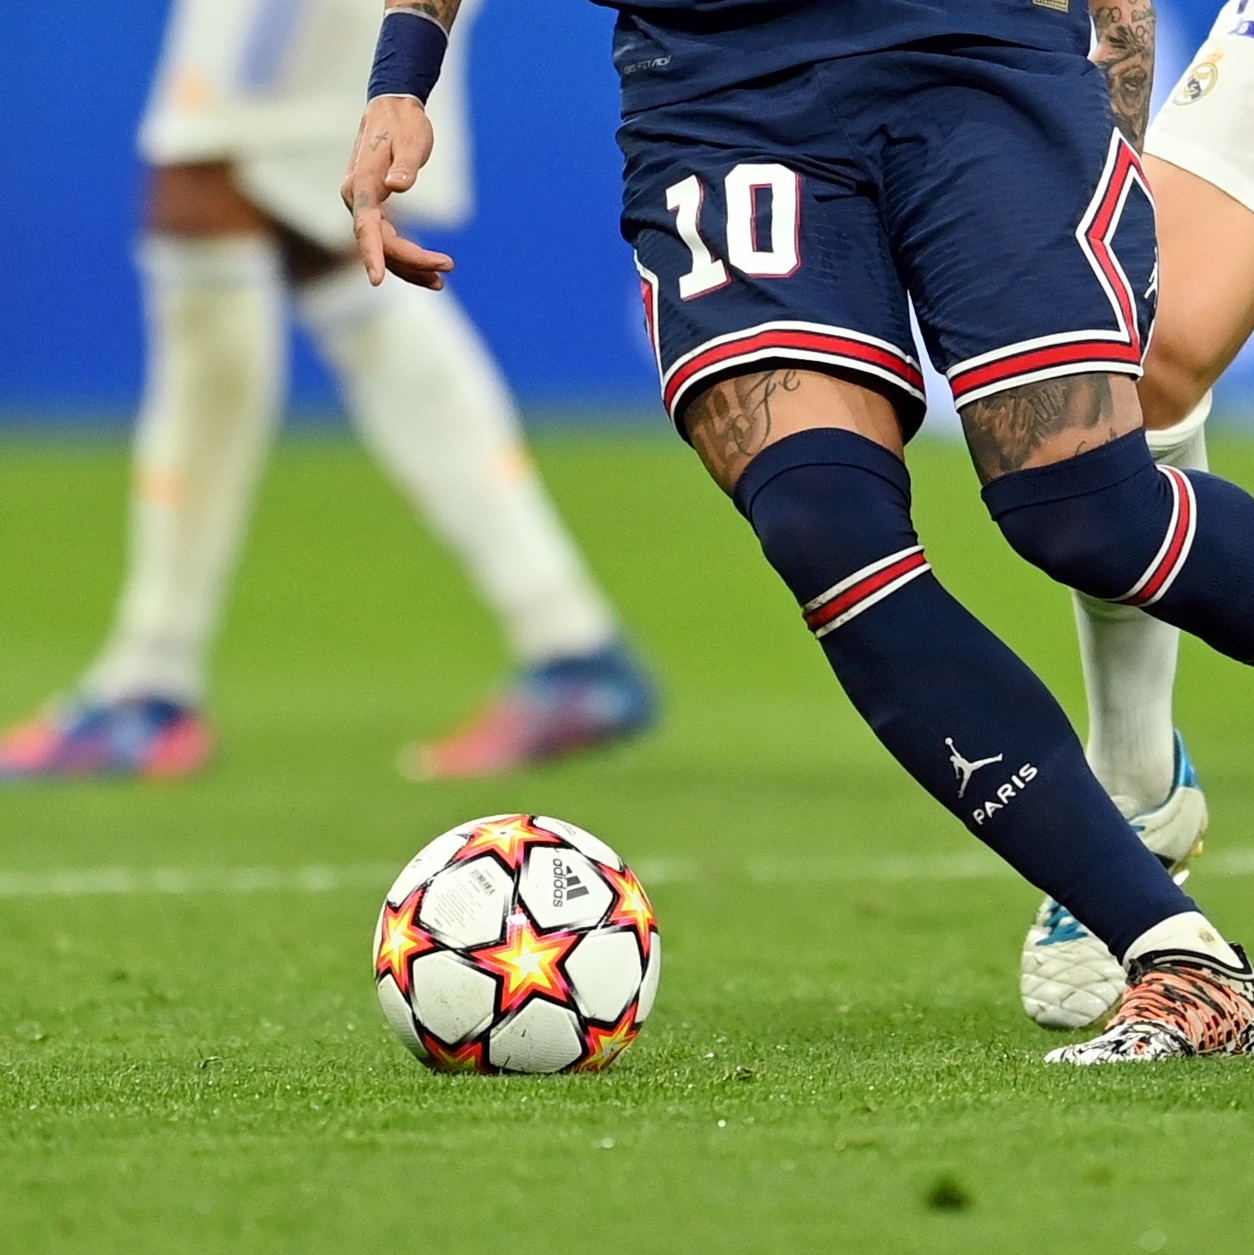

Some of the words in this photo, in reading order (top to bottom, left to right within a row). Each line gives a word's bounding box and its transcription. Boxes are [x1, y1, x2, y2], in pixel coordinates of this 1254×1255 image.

[665, 163, 802, 301] 10
[972, 763, 1038, 825] PARIS
[552, 857, 564, 908] adidas
